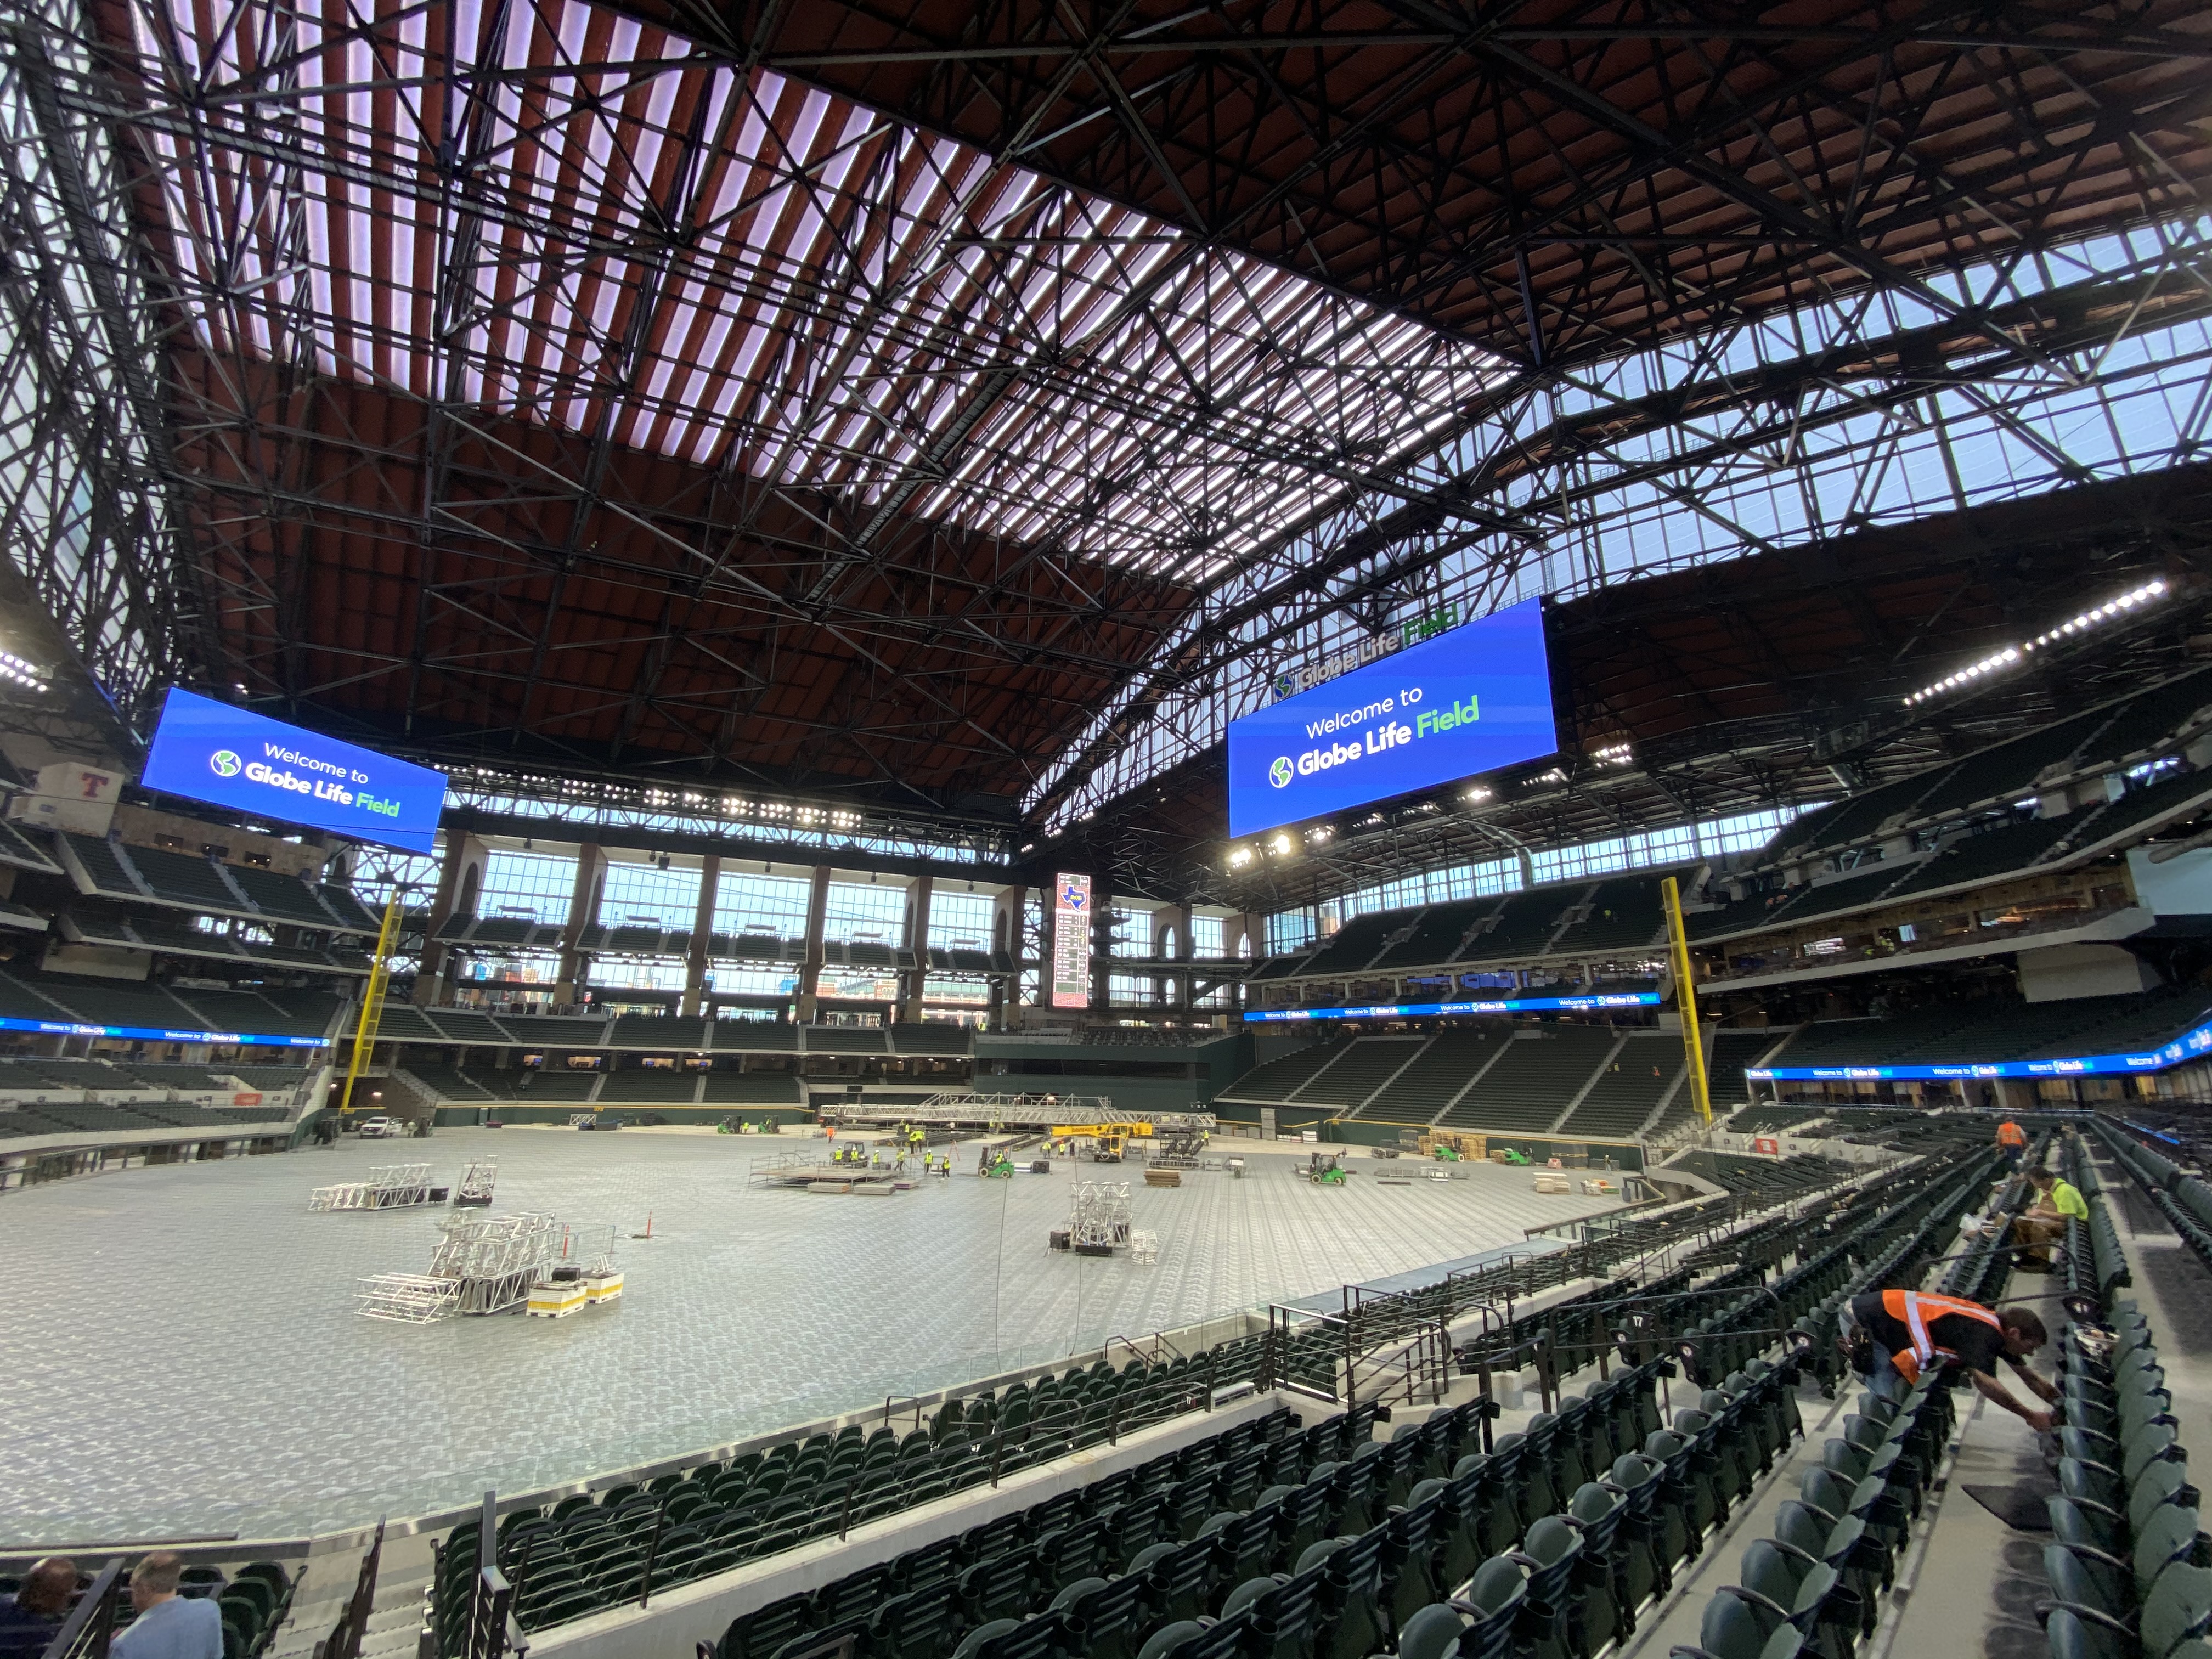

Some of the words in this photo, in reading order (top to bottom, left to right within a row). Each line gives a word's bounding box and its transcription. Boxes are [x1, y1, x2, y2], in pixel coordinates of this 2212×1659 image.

[1299, 654, 1356, 689] Globe
[1359, 632, 1399, 663] Life
[1403, 602, 1458, 646] Field
[1297, 740, 1362, 776] Globe
[1366, 721, 1412, 755] Life
[1417, 695, 1480, 738] Field
[1306, 697, 1394, 740] Welcome
[1400, 687, 1423, 712] to
[82, 772, 109, 797] T
[264, 742, 346, 778] Welcome
[351, 764, 369, 785] to
[246, 763, 310, 793] Globe
[314, 780, 353, 806] Life
[356, 792, 400, 818] Field
[1633, 1316, 1643, 1327] 17
